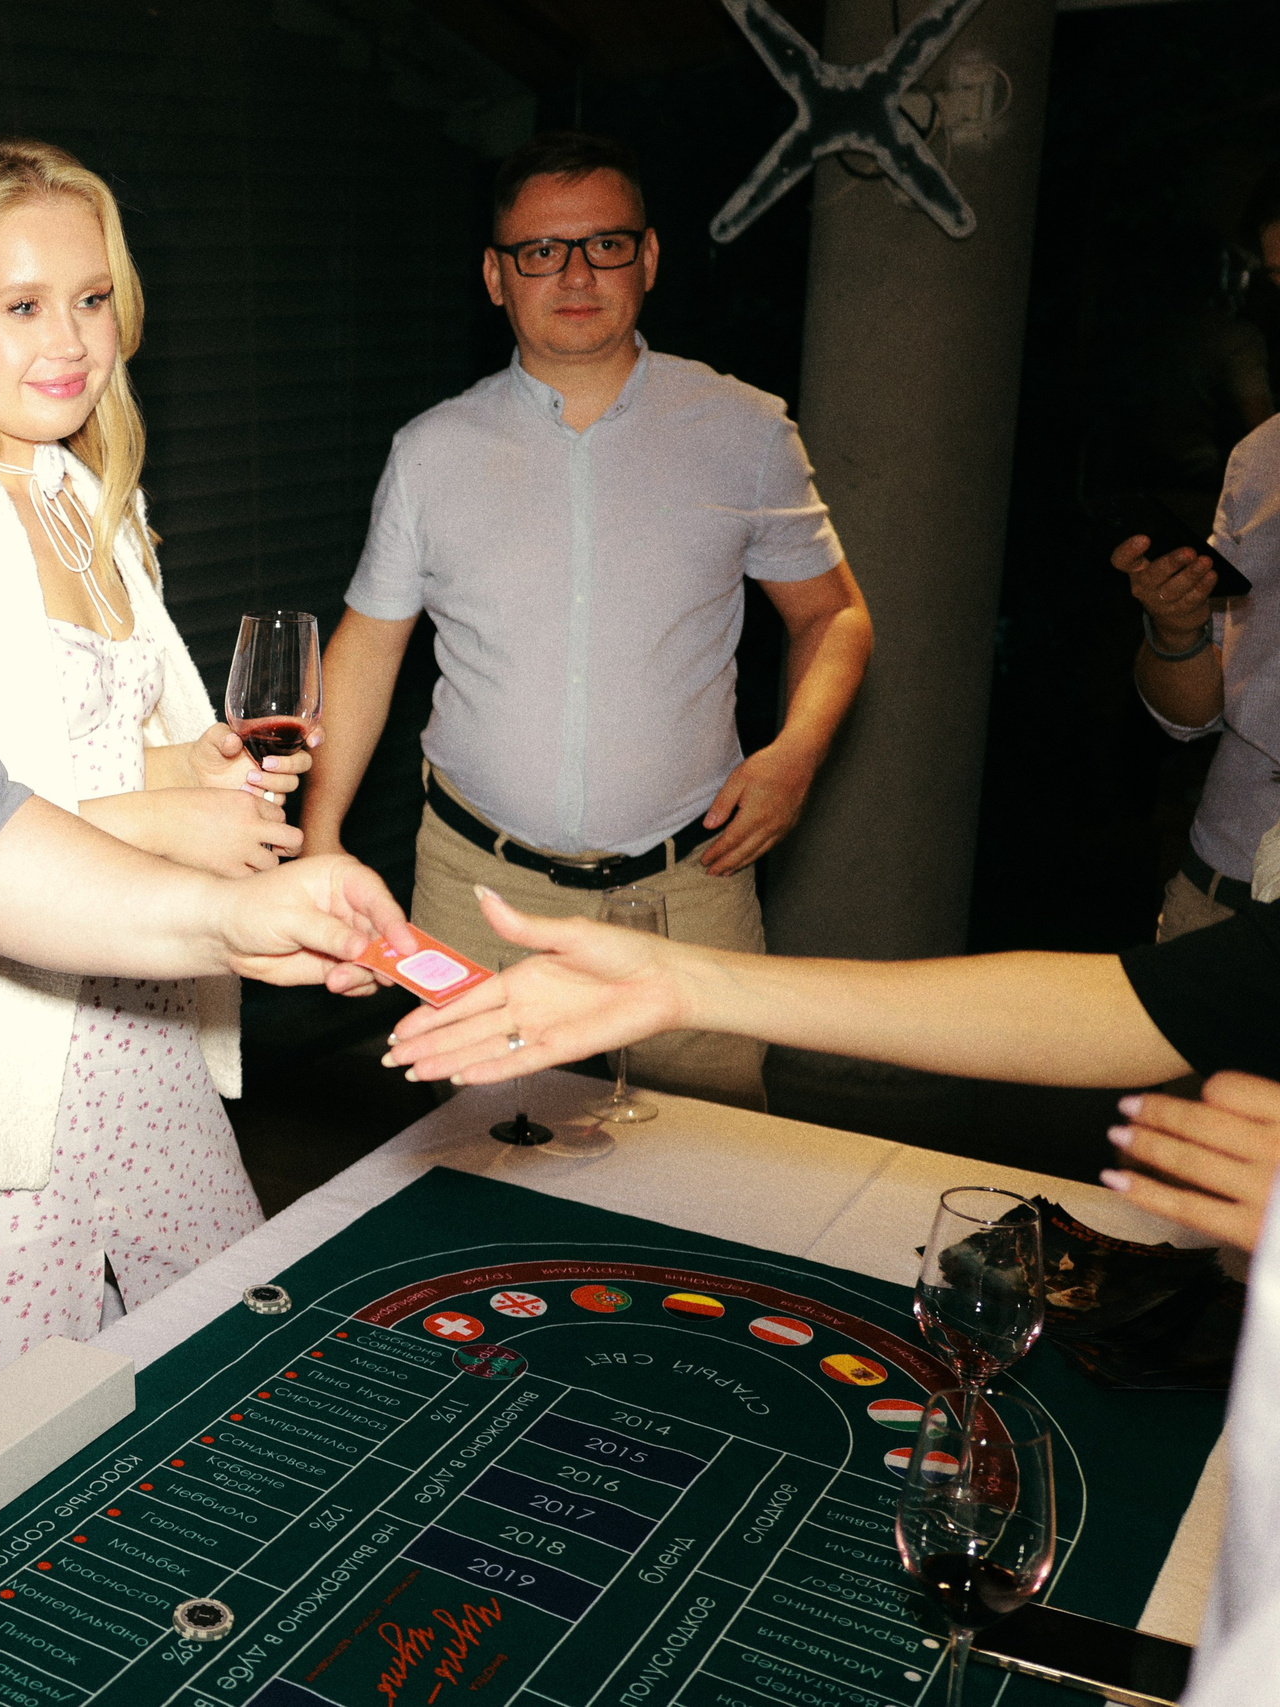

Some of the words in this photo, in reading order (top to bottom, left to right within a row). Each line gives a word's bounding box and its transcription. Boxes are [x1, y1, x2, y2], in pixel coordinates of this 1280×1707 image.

[356, 1335, 435, 1366] Совиньон
[370, 1330, 443, 1358] Каберне
[584, 1352, 654, 1367] СВЕТ
[351, 1357, 408, 1381] Мерло
[307, 1370, 351, 1390] Пино
[356, 1386, 401, 1408] Нуар
[672, 1360, 770, 1416] СТАРЫЙ
[274, 1387, 388, 1431] Сира/Шираз
[430, 1399, 469, 1424] 11%
[460, 1391, 540, 1458] выдержано
[611, 1411, 672, 1436] 2014
[243, 1408, 358, 1454] Темпранильо
[218, 1433, 327, 1476] Санджовезе
[449, 1459, 467, 1469] в
[584, 1437, 649, 1464] 2015
[54, 1454, 143, 1518] красные
[206, 1455, 285, 1489] Каберне
[414, 1468, 455, 1504] дубе
[557, 1465, 622, 1492] 2016
[169, 1483, 258, 1524] Неббиоло
[309, 1504, 353, 1532] 12%
[529, 1494, 596, 1521] 2017
[743, 1483, 798, 1544] сладкое
[140, 1511, 218, 1548] Гарнача
[371, 1523, 400, 1545] не
[499, 1525, 567, 1556] 2018
[107, 1538, 192, 1577] Мальбек
[467, 1558, 536, 1587] 2019
[638, 1537, 696, 1584] бленд
[57, 1557, 171, 1611] Красностоп
[277, 1544, 378, 1633] выдержано
[839, 1573, 910, 1603] Виура
[6, 1579, 149, 1647] Монтепульчано
[772, 1594, 918, 1654] Верментино
[161, 1638, 203, 1666] 3%
[263, 1633, 283, 1645] в
[620, 1596, 716, 1707] полусладкое
[758, 1626, 883, 1679] Мальвазия
[217, 1644, 267, 1689] дубе
